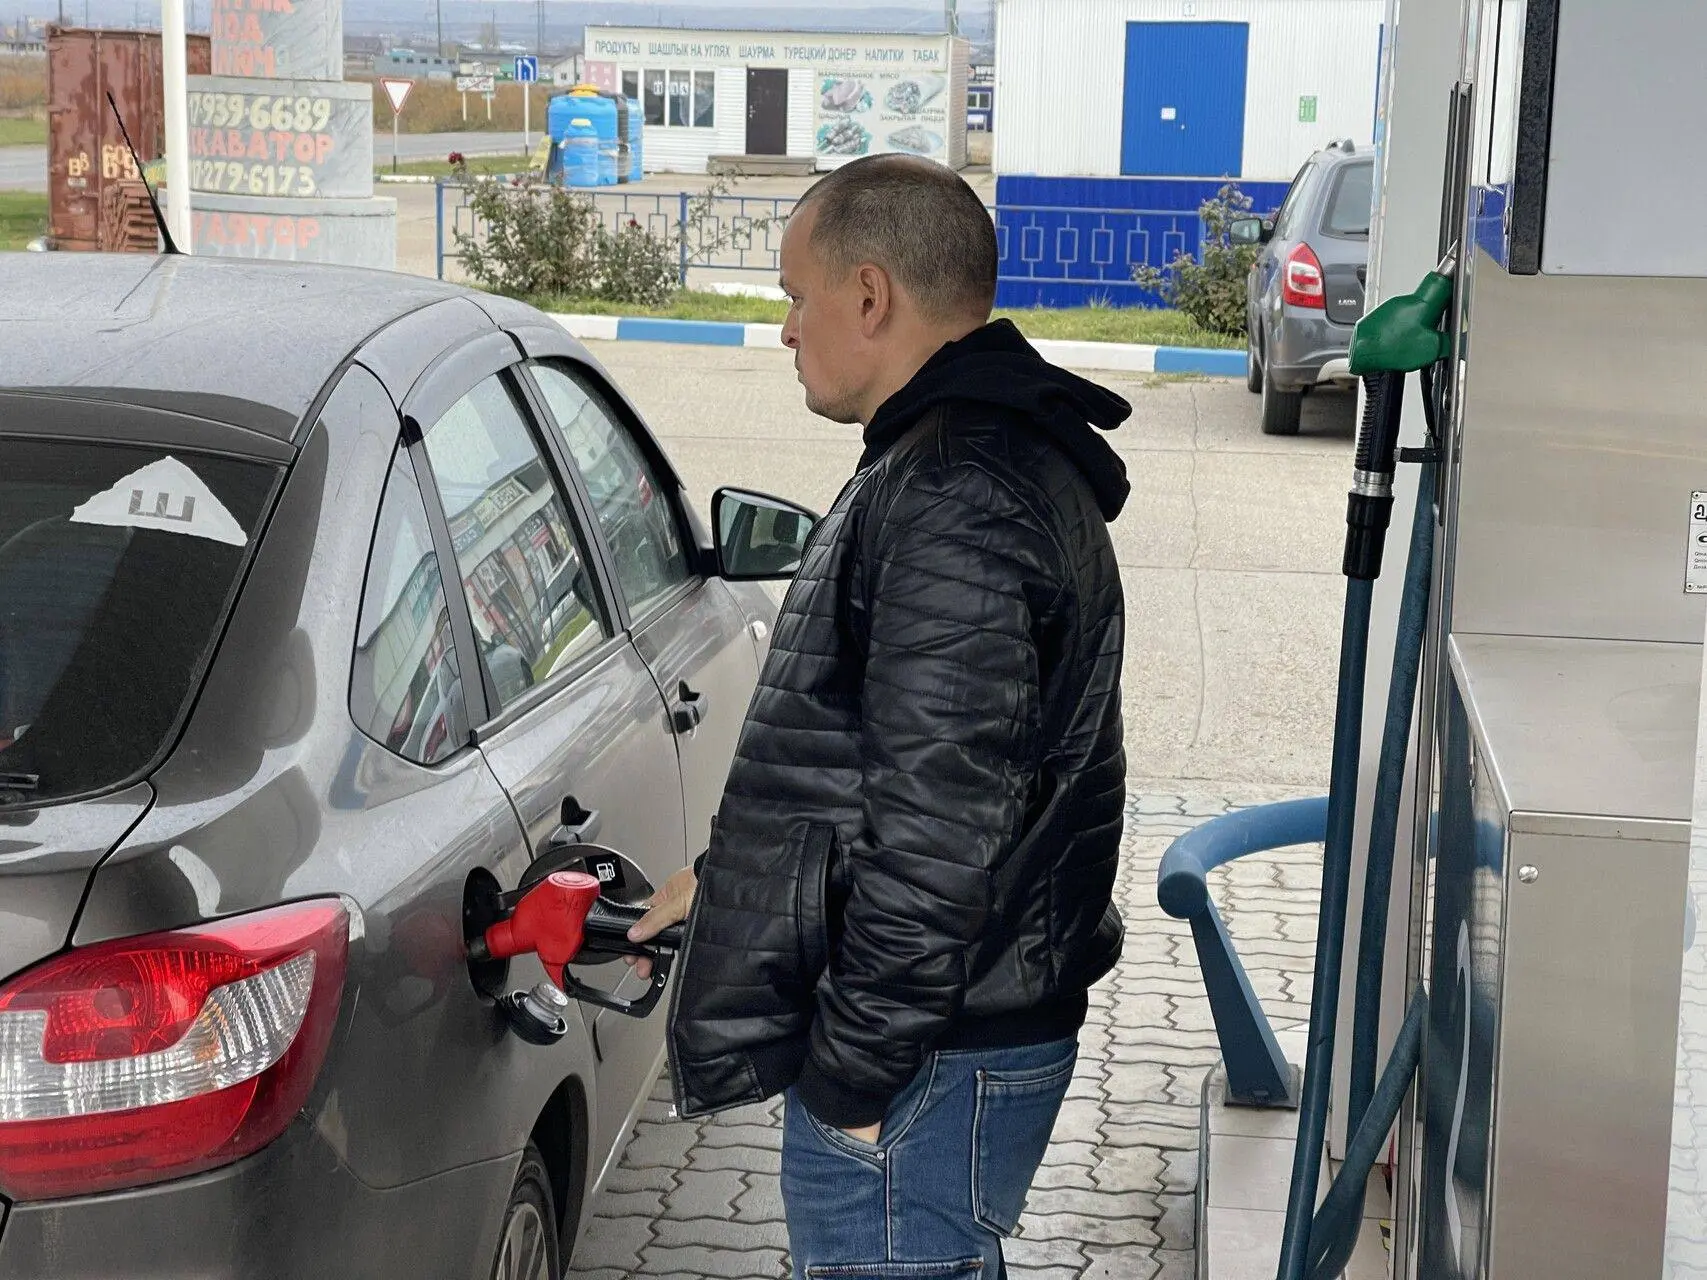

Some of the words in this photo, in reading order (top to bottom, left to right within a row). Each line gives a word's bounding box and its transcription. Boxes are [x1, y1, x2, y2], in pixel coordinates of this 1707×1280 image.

[595, 40, 640, 56] ПРОДУКТЫ
[649, 42, 688, 56] ШАШЛЫК
[691, 43, 702, 56] НА
[705, 44, 731, 58] УГЛЯХ
[739, 45, 775, 59] ШАУРМА
[784, 44, 826, 62] ТУРЕЦКИЙ
[827, 48, 857, 62] ДОНЕР
[865, 48, 905, 62] НАПИТКИ
[913, 49, 939, 62] ТАБАК
